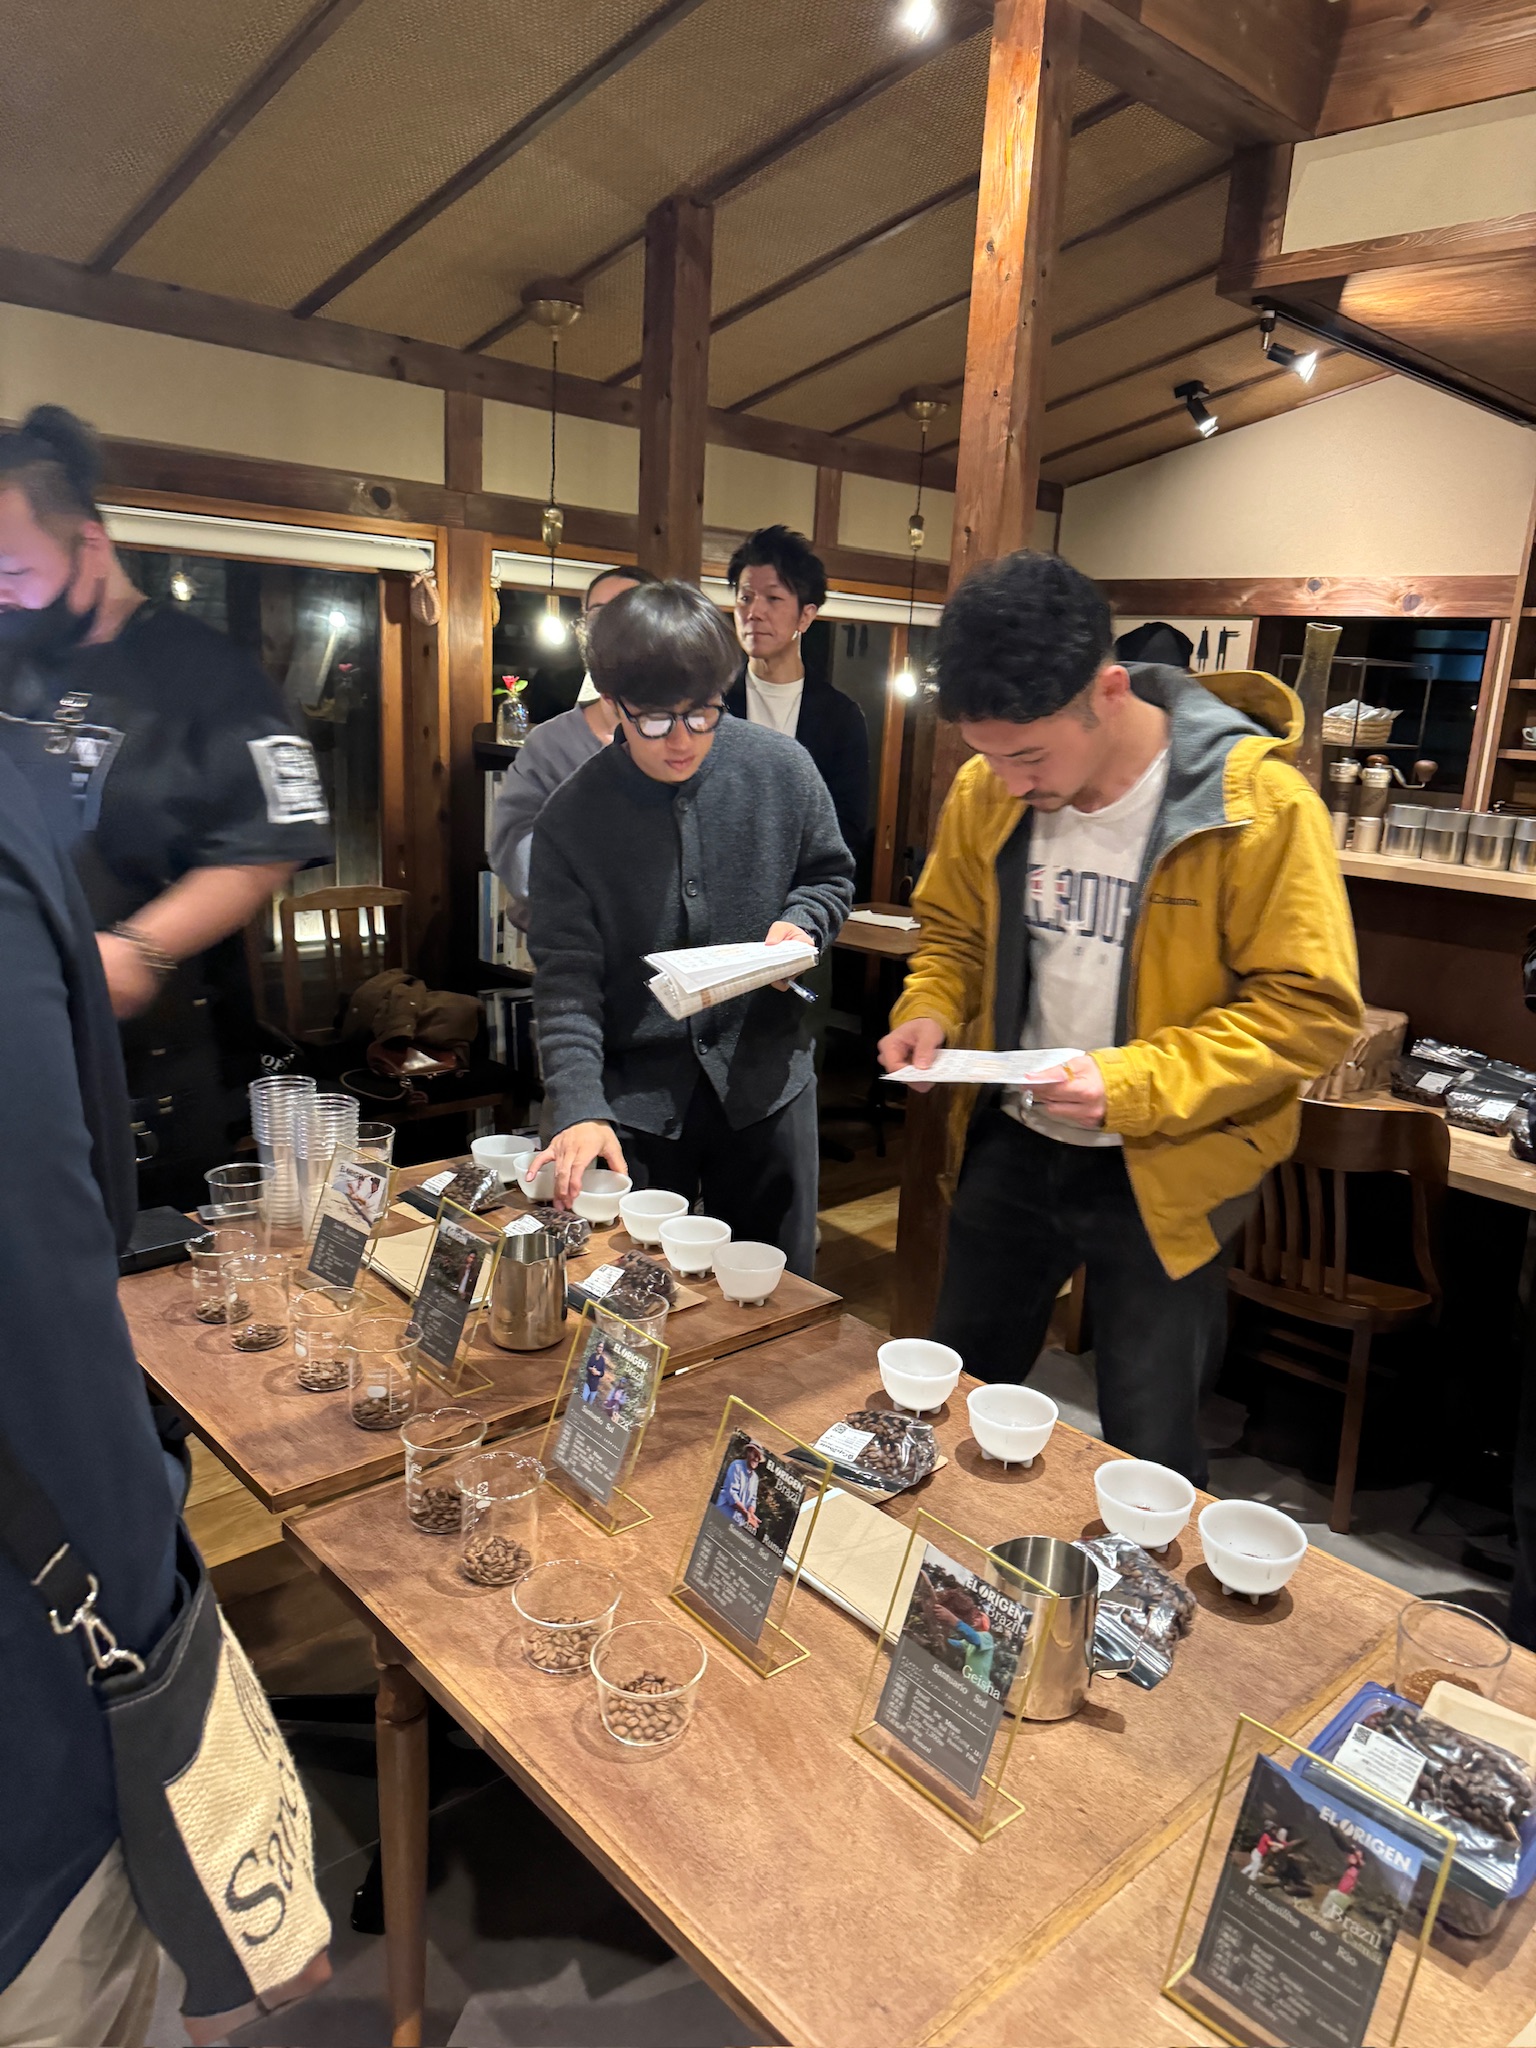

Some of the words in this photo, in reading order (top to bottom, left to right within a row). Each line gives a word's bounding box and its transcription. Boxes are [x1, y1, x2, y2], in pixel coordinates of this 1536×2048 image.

[774, 1479, 802, 1505] Brazil
[986, 1604, 1021, 1635] Brazil
[962, 1664, 1001, 1700] Geisha
[973, 1693, 989, 1709] Sul
[1325, 1902, 1382, 1950] Brazil
[1309, 1930, 1327, 1946] do
[1336, 1945, 1358, 1967] Rio
